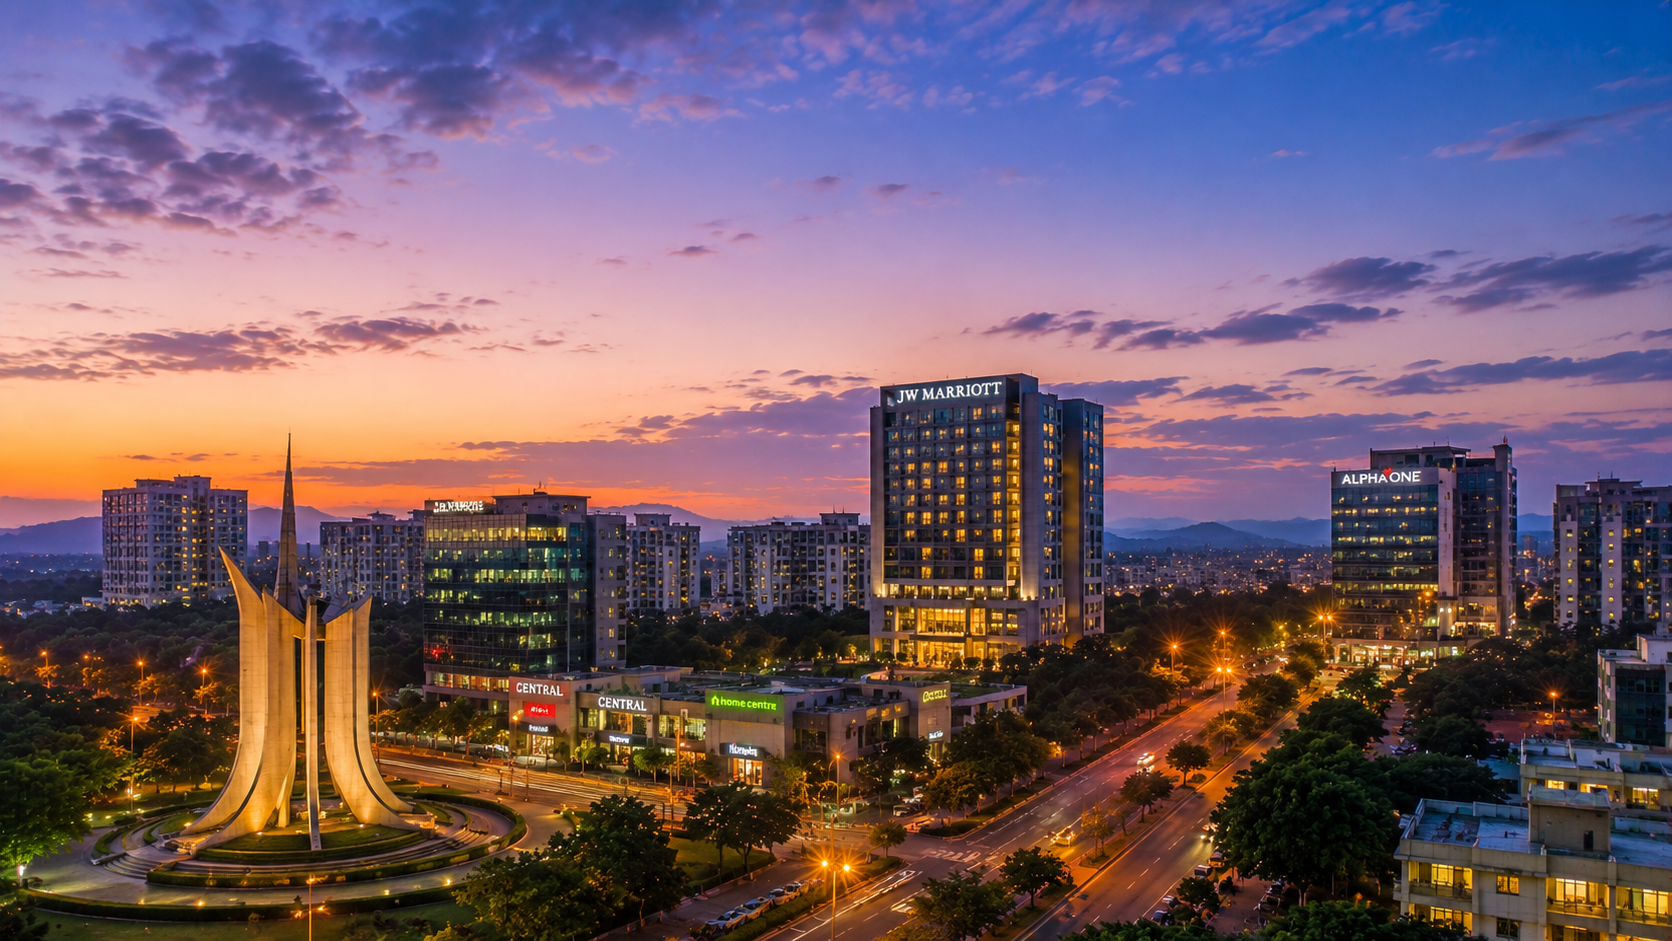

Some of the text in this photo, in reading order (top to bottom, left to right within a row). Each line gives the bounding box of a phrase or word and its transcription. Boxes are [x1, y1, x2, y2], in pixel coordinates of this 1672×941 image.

[897, 382, 1002, 404] JW MARRIOTT
[1342, 471, 1422, 485] ALPHA ONE
[516, 682, 563, 696] CENTRAL
[598, 697, 647, 711] CENTRAL
[720, 696, 777, 711] home centre
